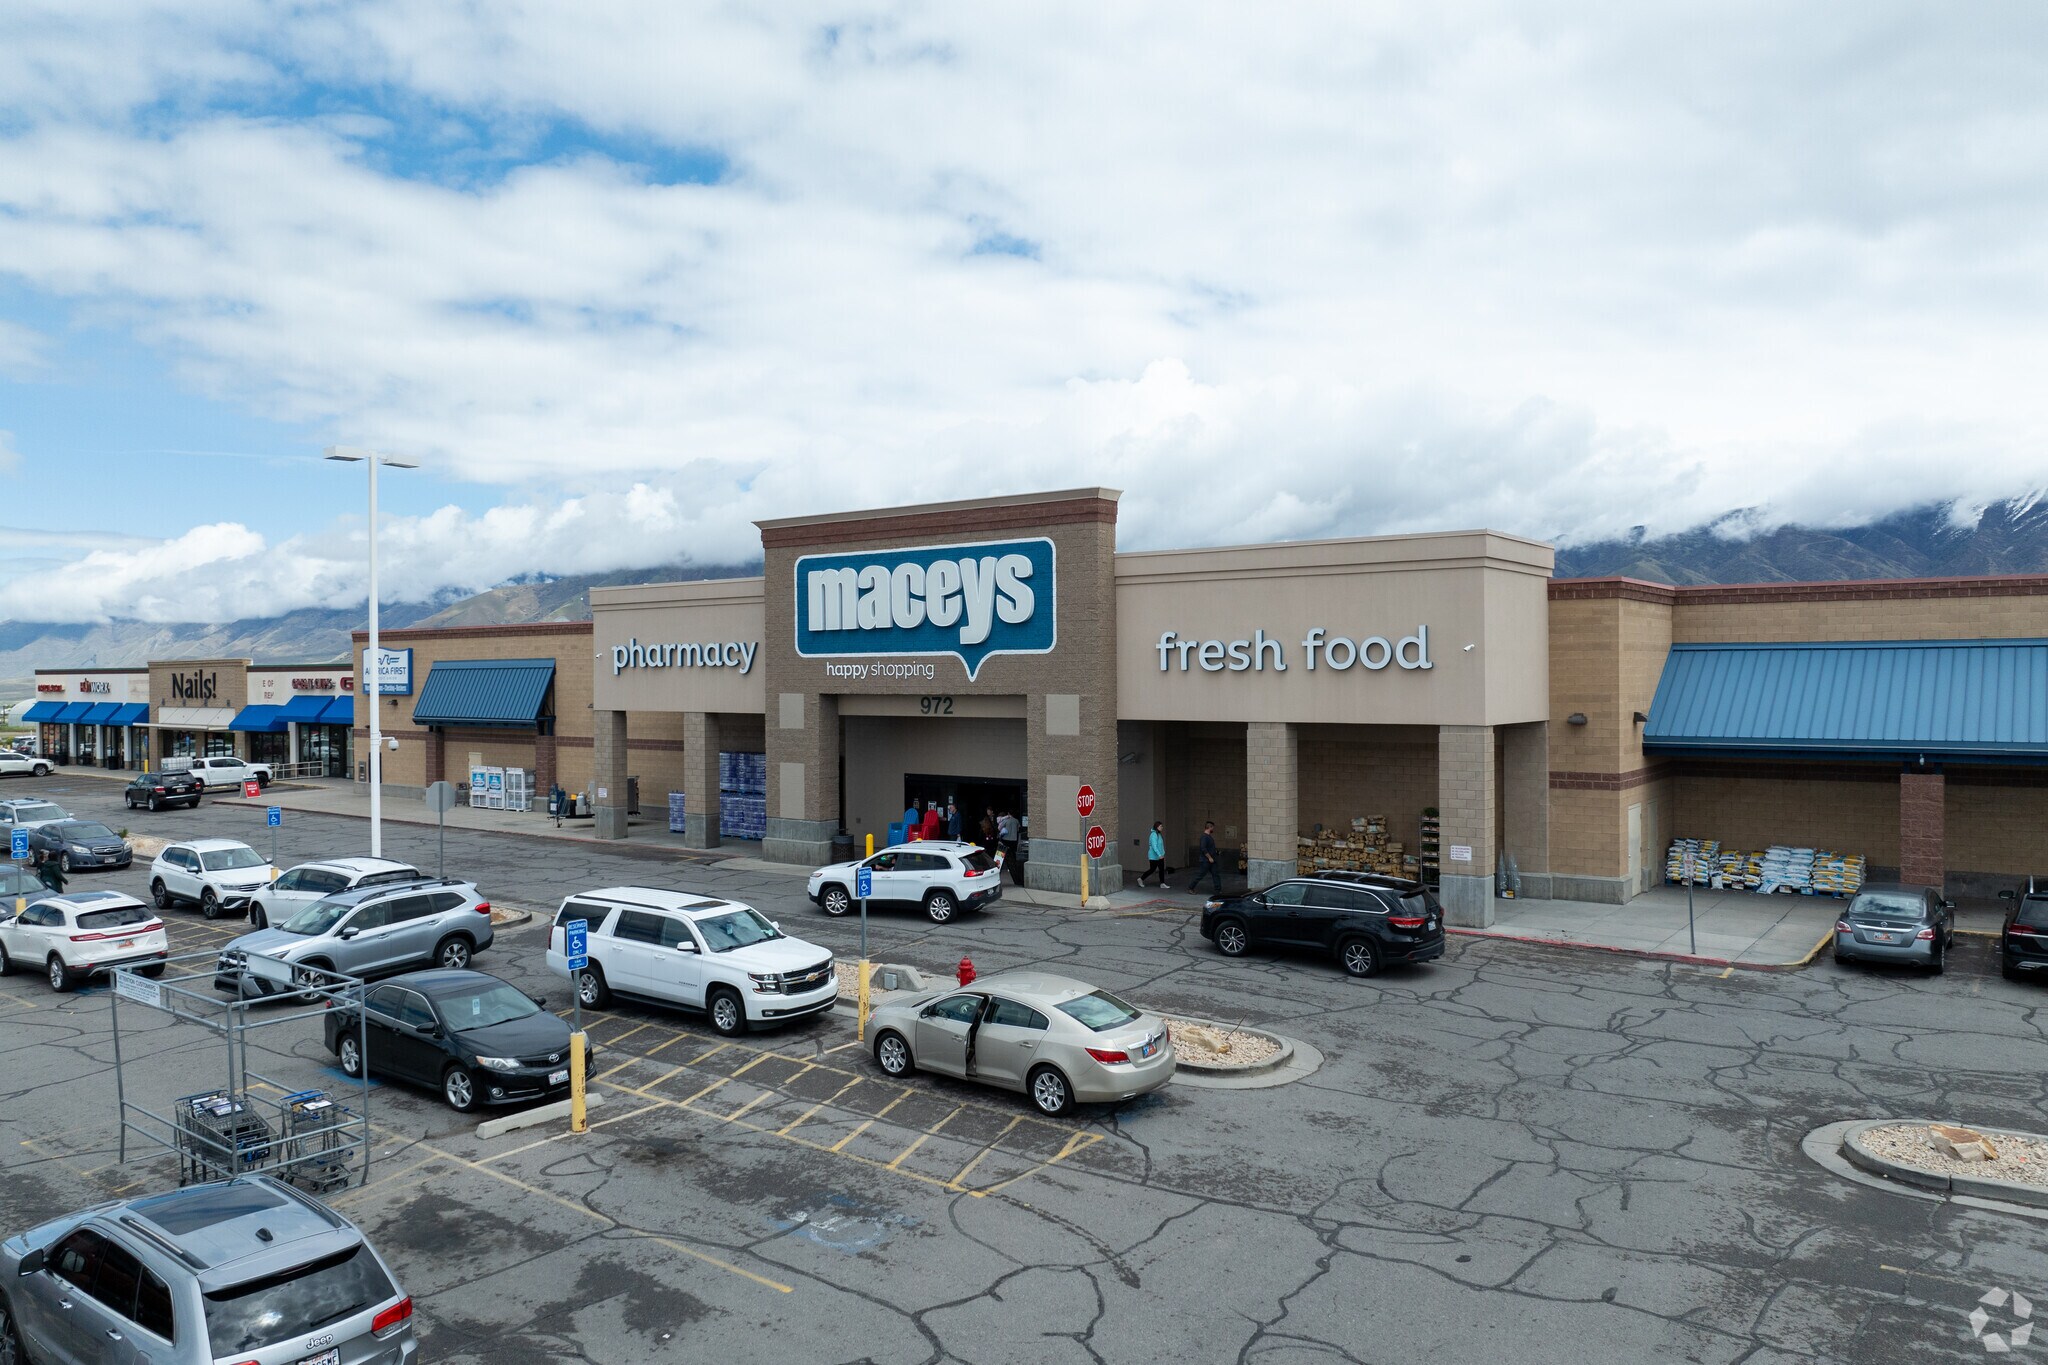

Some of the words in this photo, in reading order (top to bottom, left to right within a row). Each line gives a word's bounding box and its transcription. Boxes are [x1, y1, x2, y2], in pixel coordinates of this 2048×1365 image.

[808, 553, 1035, 645] maceys
[611, 638, 759, 676] pharmacy
[1155, 629, 1288, 672] fresh
[1301, 624, 1434, 671] food
[826, 661, 869, 679] happy
[871, 661, 935, 680] shopping
[171, 669, 217, 699] Nails!
[920, 696, 954, 715] 972
[1078, 794, 1093, 807] STOP
[1088, 836, 1104, 849] STOP
[306, 1334, 334, 1350] Jeep
